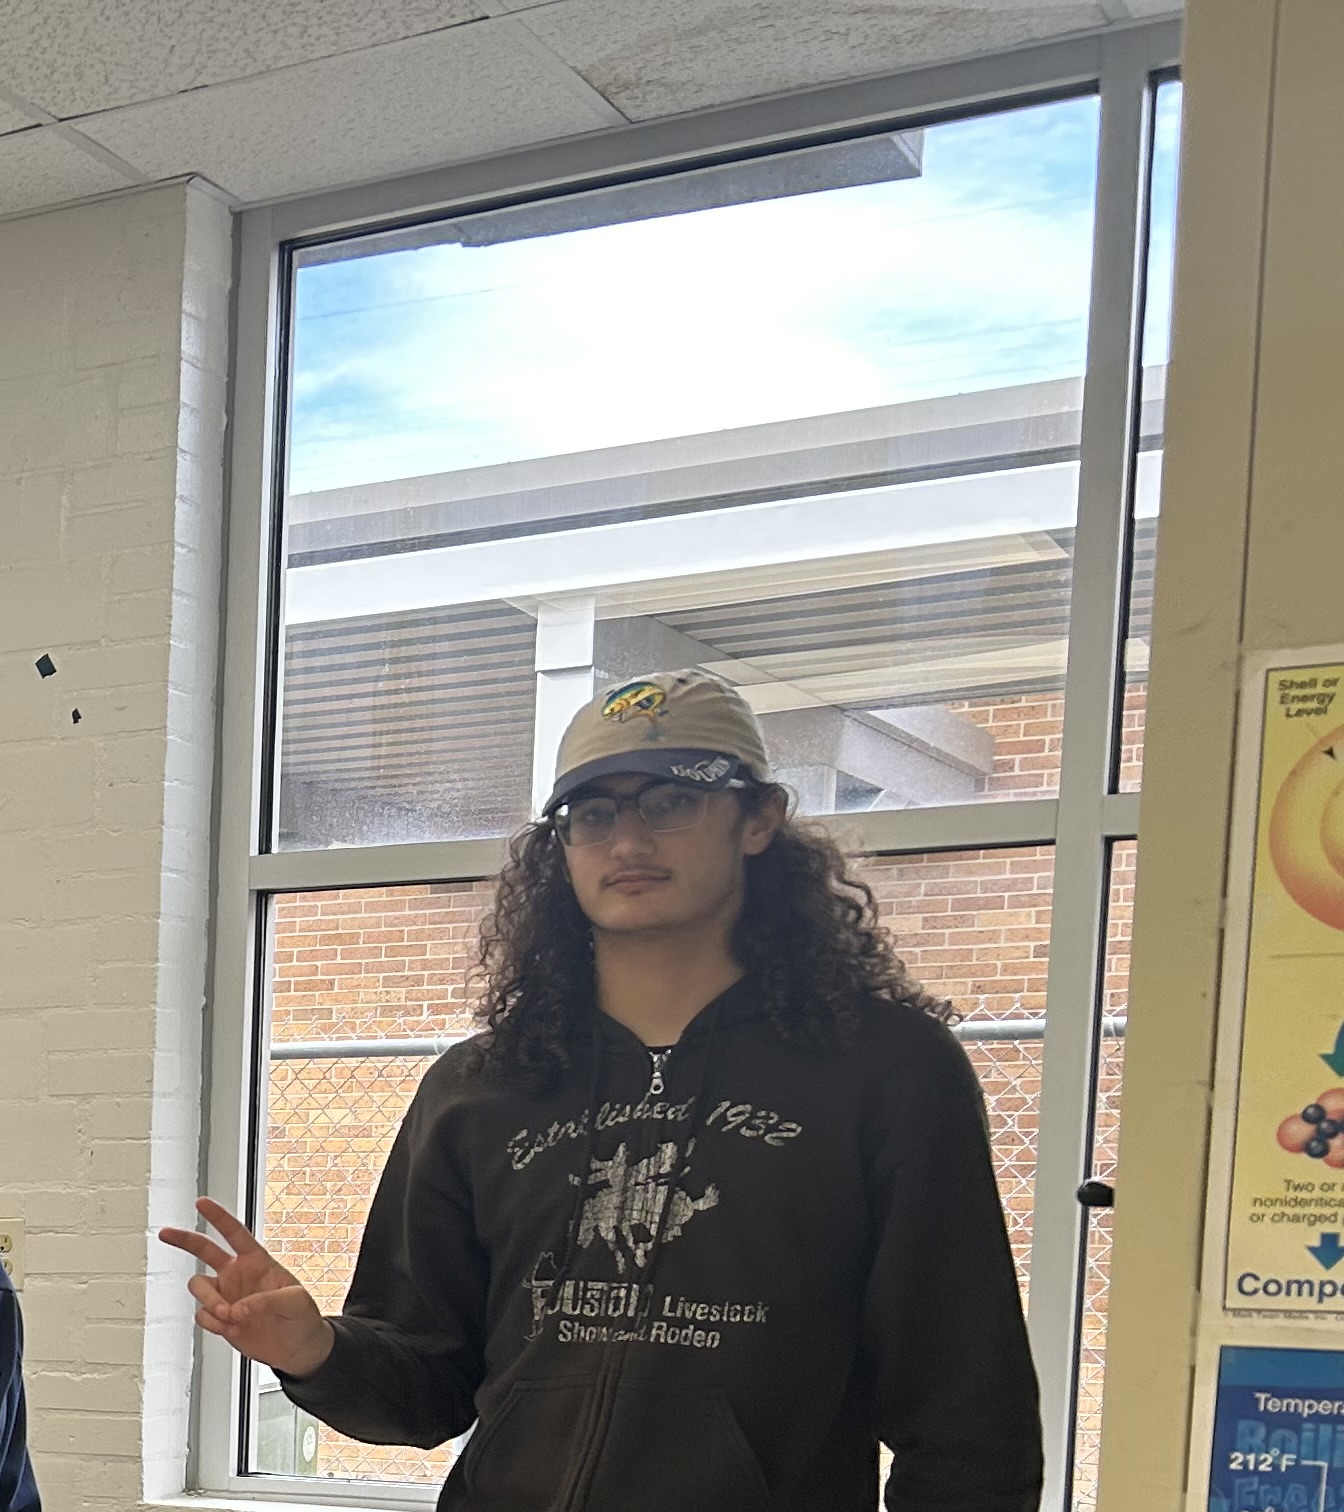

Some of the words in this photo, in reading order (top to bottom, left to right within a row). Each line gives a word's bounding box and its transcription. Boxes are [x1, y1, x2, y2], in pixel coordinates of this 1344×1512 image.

[706, 1100, 802, 1147] 1932
[1284, 1178, 1316, 1193] Two
[1319, 1181, 1337, 1193] or
[1249, 1212, 1266, 1224] or
[1270, 1211, 1339, 1226] charged
[1237, 1272, 1344, 1304] Comp
[662, 1295, 770, 1323] Livestock
[650, 1321, 721, 1348] Rodeo
